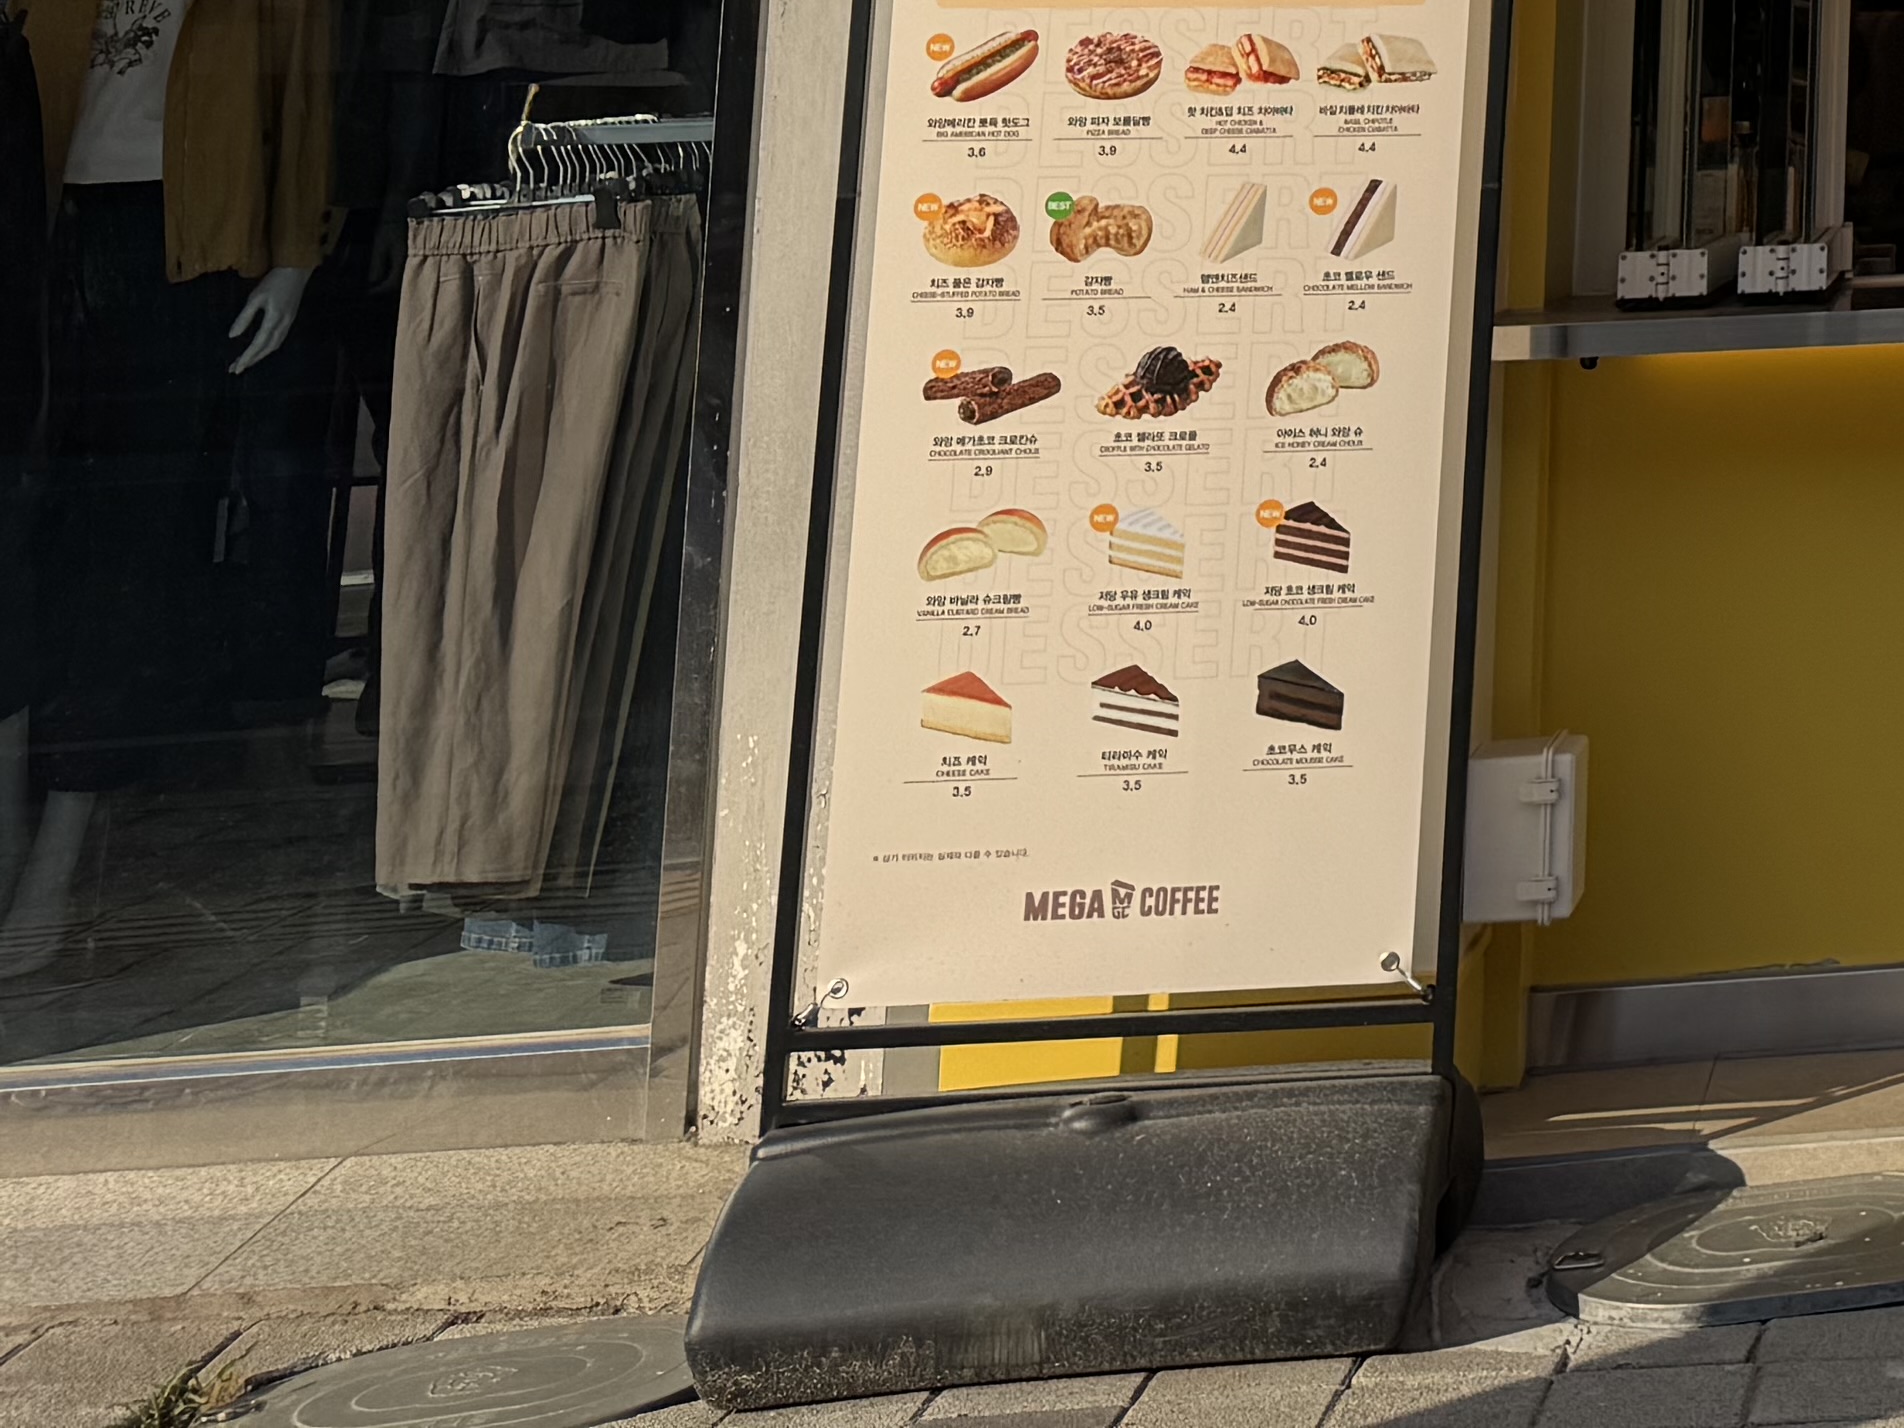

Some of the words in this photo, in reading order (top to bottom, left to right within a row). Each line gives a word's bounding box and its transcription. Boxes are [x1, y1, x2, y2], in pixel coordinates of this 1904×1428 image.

[930, 42, 953, 53] NEW
[967, 147, 986, 158] 3.6
[1098, 145, 1117, 156] 3.9
[1228, 144, 1247, 154] 4.4
[1358, 142, 1376, 152] 4.4
[1047, 199, 1073, 211] BEST
[1312, 196, 1335, 207] NEW
[1084, 275, 1113, 287] 감자빵
[1086, 305, 1106, 316] 3.5
[1217, 303, 1236, 313] 2.4
[1347, 300, 1366, 311] 2.4
[955, 307, 974, 318] 3.9
[935, 358, 958, 369] NEW
[1144, 461, 1163, 472] 3.5
[1308, 457, 1327, 468] 2.4
[973, 465, 993, 477] 2.9
[1260, 508, 1282, 520] NEW
[1133, 619, 1152, 631] 4.0
[1298, 614, 1317, 626] 4.0
[962, 624, 981, 636] 2.7
[1287, 773, 1307, 786] 3.5
[1122, 779, 1142, 792] 3.5
[952, 785, 972, 798] 3.5
[1022, 889, 1106, 923] MEGA
[1139, 884, 1221, 918] COFFEE
